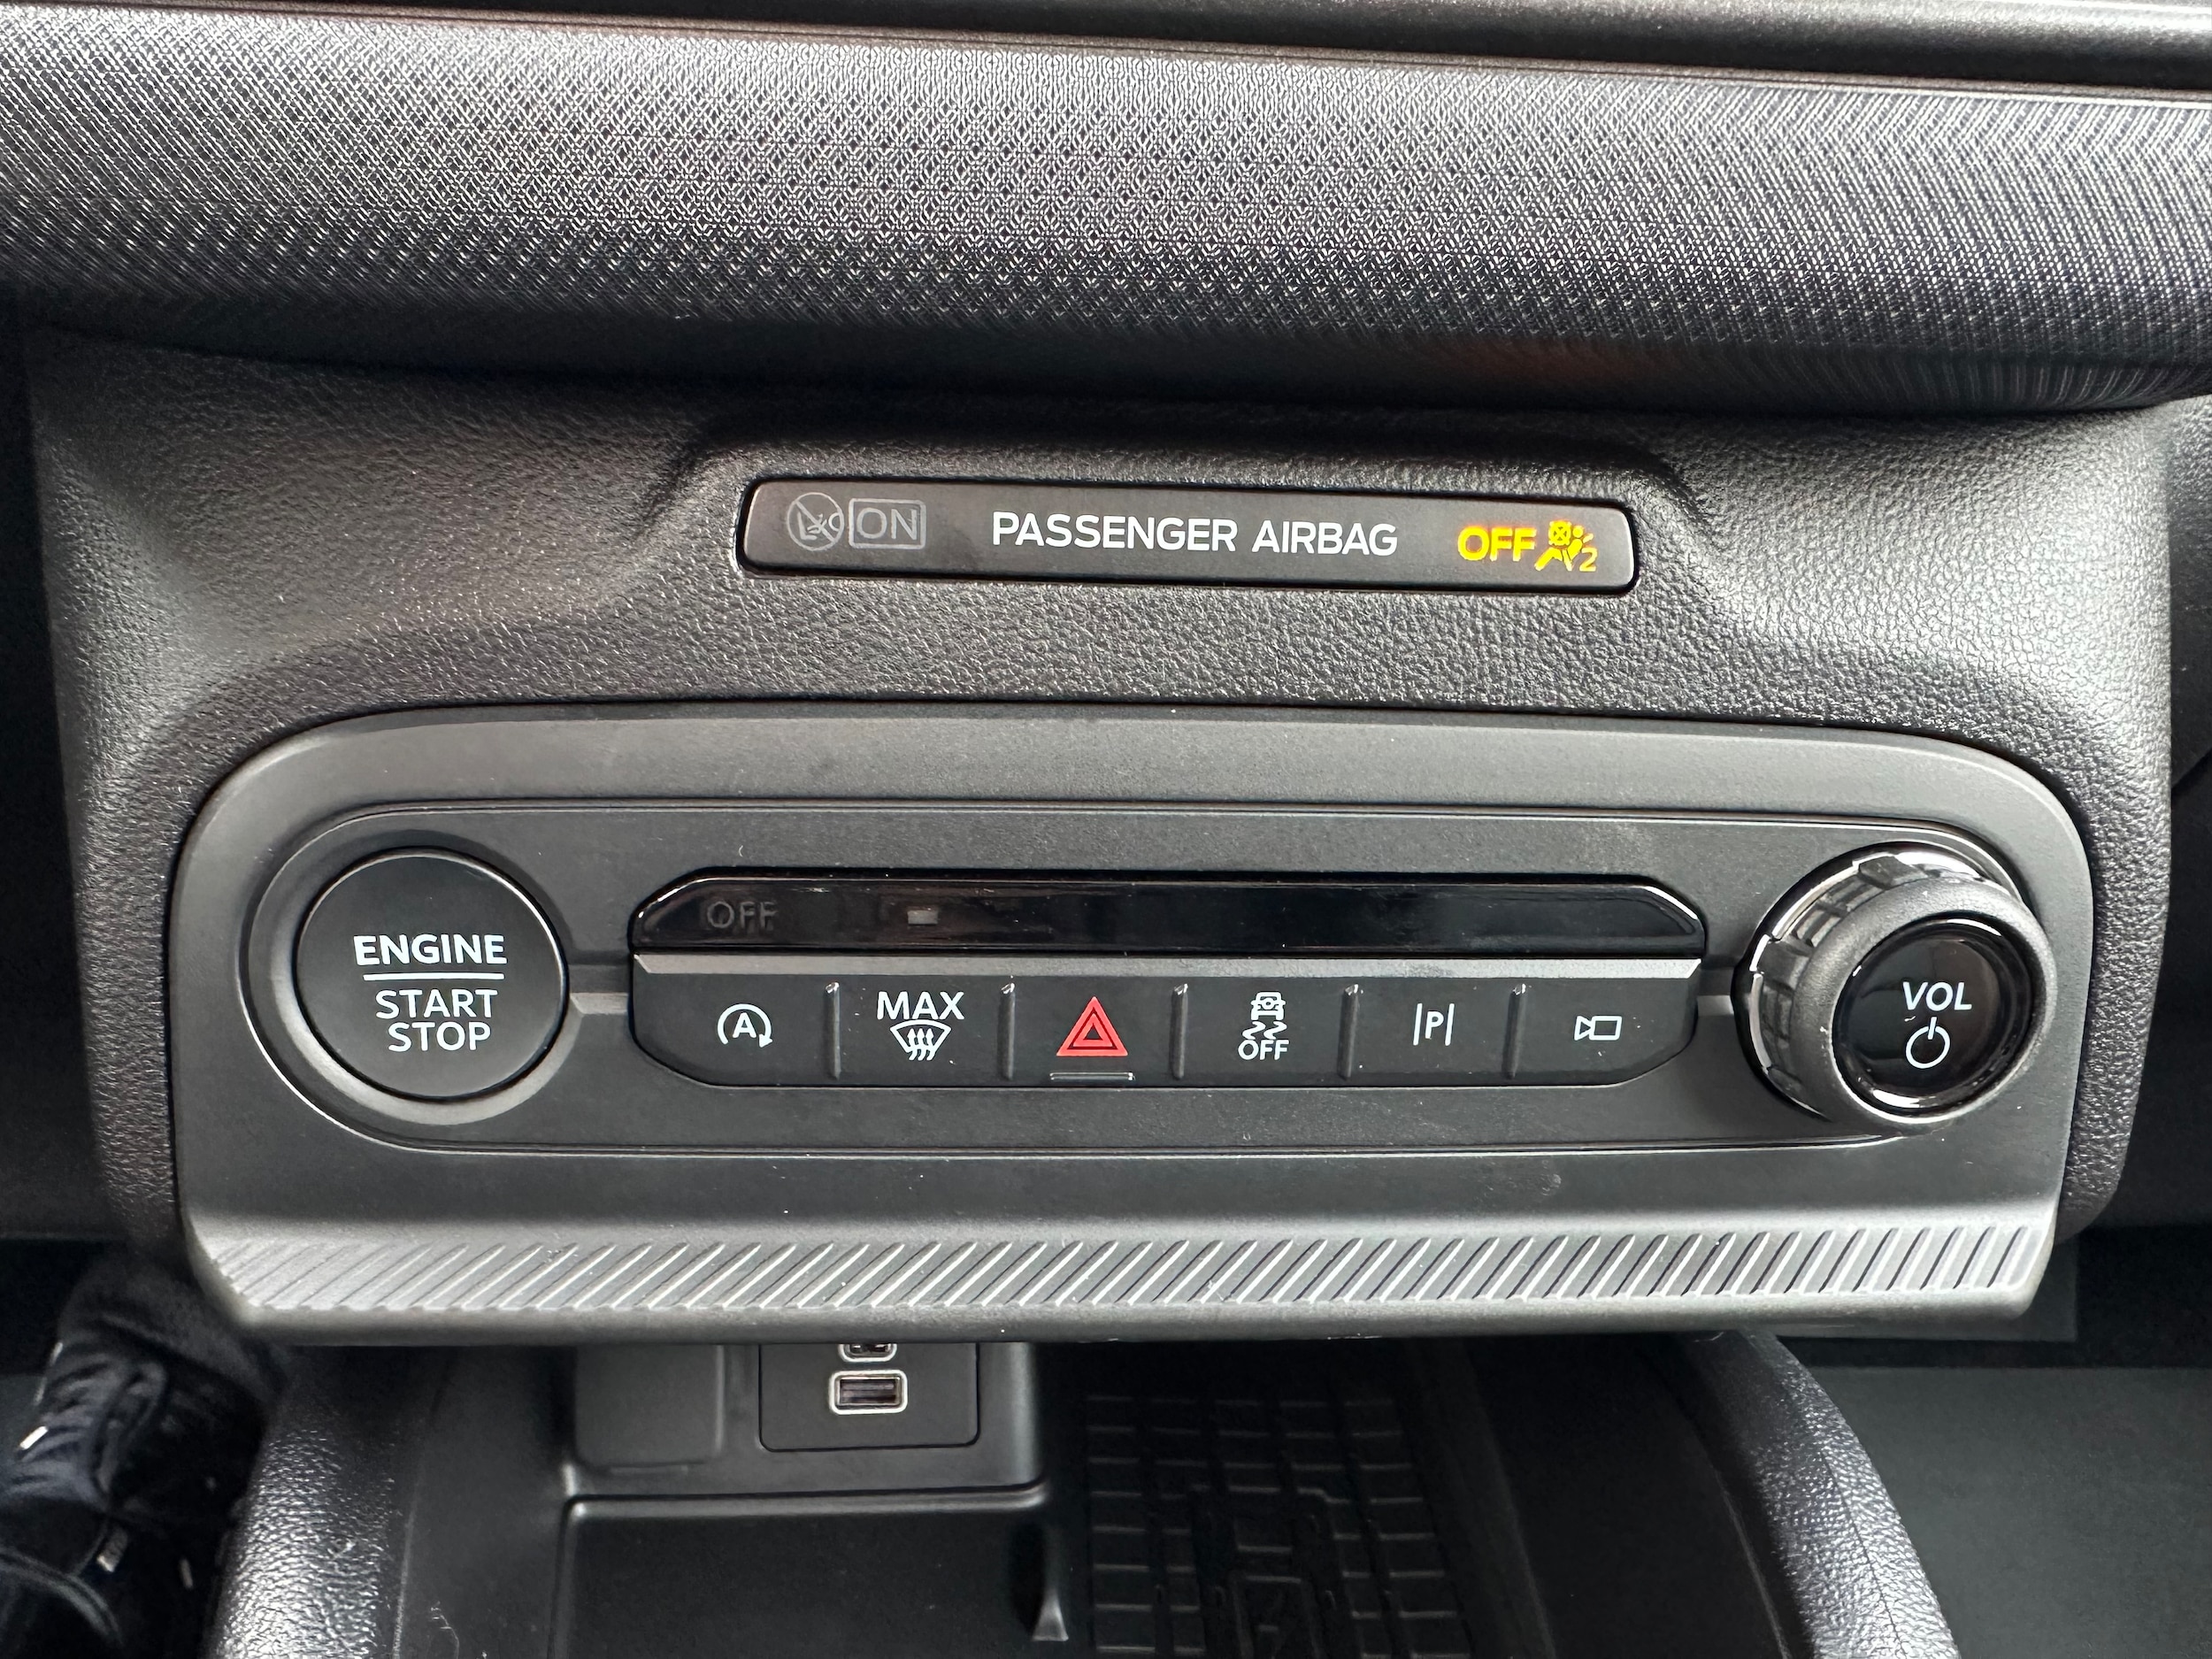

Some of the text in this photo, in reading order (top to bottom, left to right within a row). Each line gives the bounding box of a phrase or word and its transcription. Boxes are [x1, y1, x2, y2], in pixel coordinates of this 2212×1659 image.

[856, 506, 918, 541] ON
[992, 511, 1399, 557] PASSENGER AIRBAG
[1457, 526, 1537, 562] OFF
[706, 901, 779, 932] OFF
[354, 934, 507, 966] ENGINE
[375, 989, 498, 1019] START
[876, 991, 964, 1020] MAX
[1901, 981, 1972, 1011] VOL
[388, 1021, 492, 1051] STOP
[732, 1013, 758, 1039] A
[1425, 1010, 1444, 1040] P
[1238, 1039, 1290, 1061] OFF
